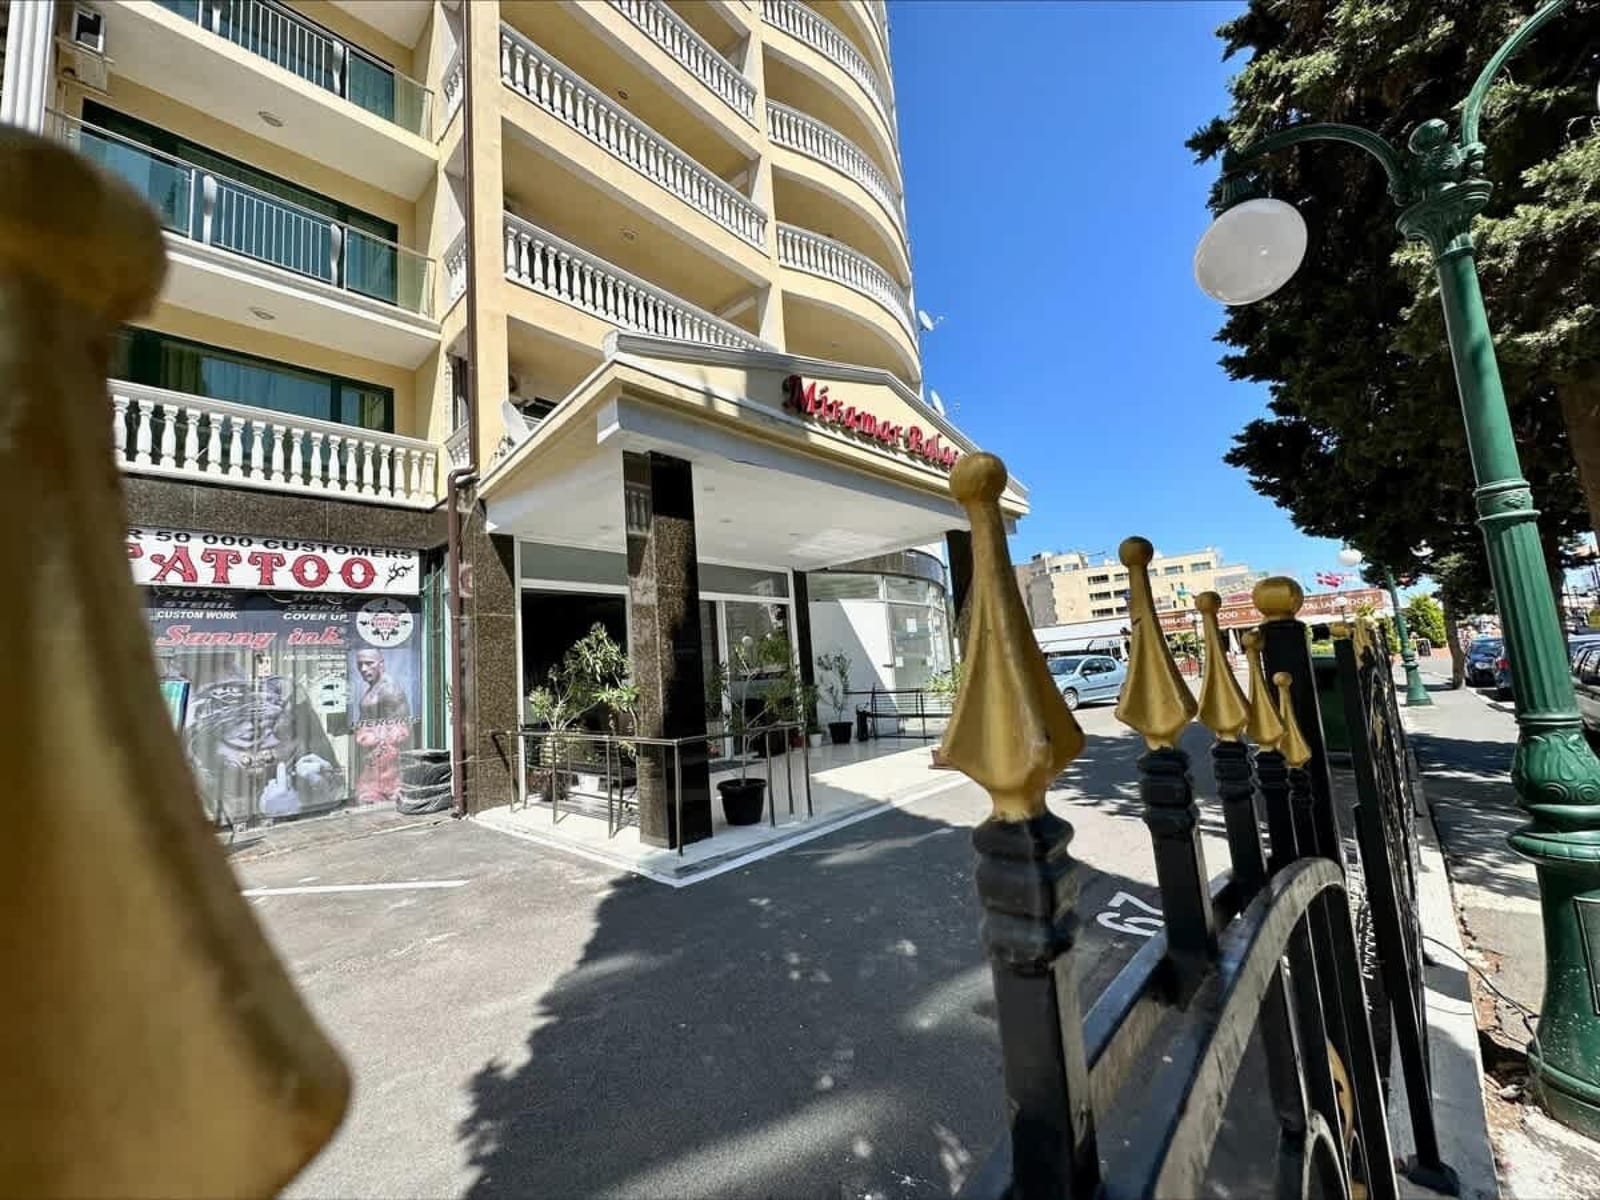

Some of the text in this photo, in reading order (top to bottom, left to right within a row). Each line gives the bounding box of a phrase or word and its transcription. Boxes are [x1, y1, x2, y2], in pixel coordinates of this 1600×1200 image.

[780, 374, 903, 445] Miramar
[155, 530, 192, 543] 50
[202, 533, 253, 547] 000
[262, 538, 413, 560] CUSTOMERS
[128, 543, 378, 590] ATTOO
[157, 610, 238, 620] CUSTOM WORK
[283, 612, 327, 622] COVER
[155, 624, 345, 649] Sunny ink
[1096, 891, 1165, 937] 67
